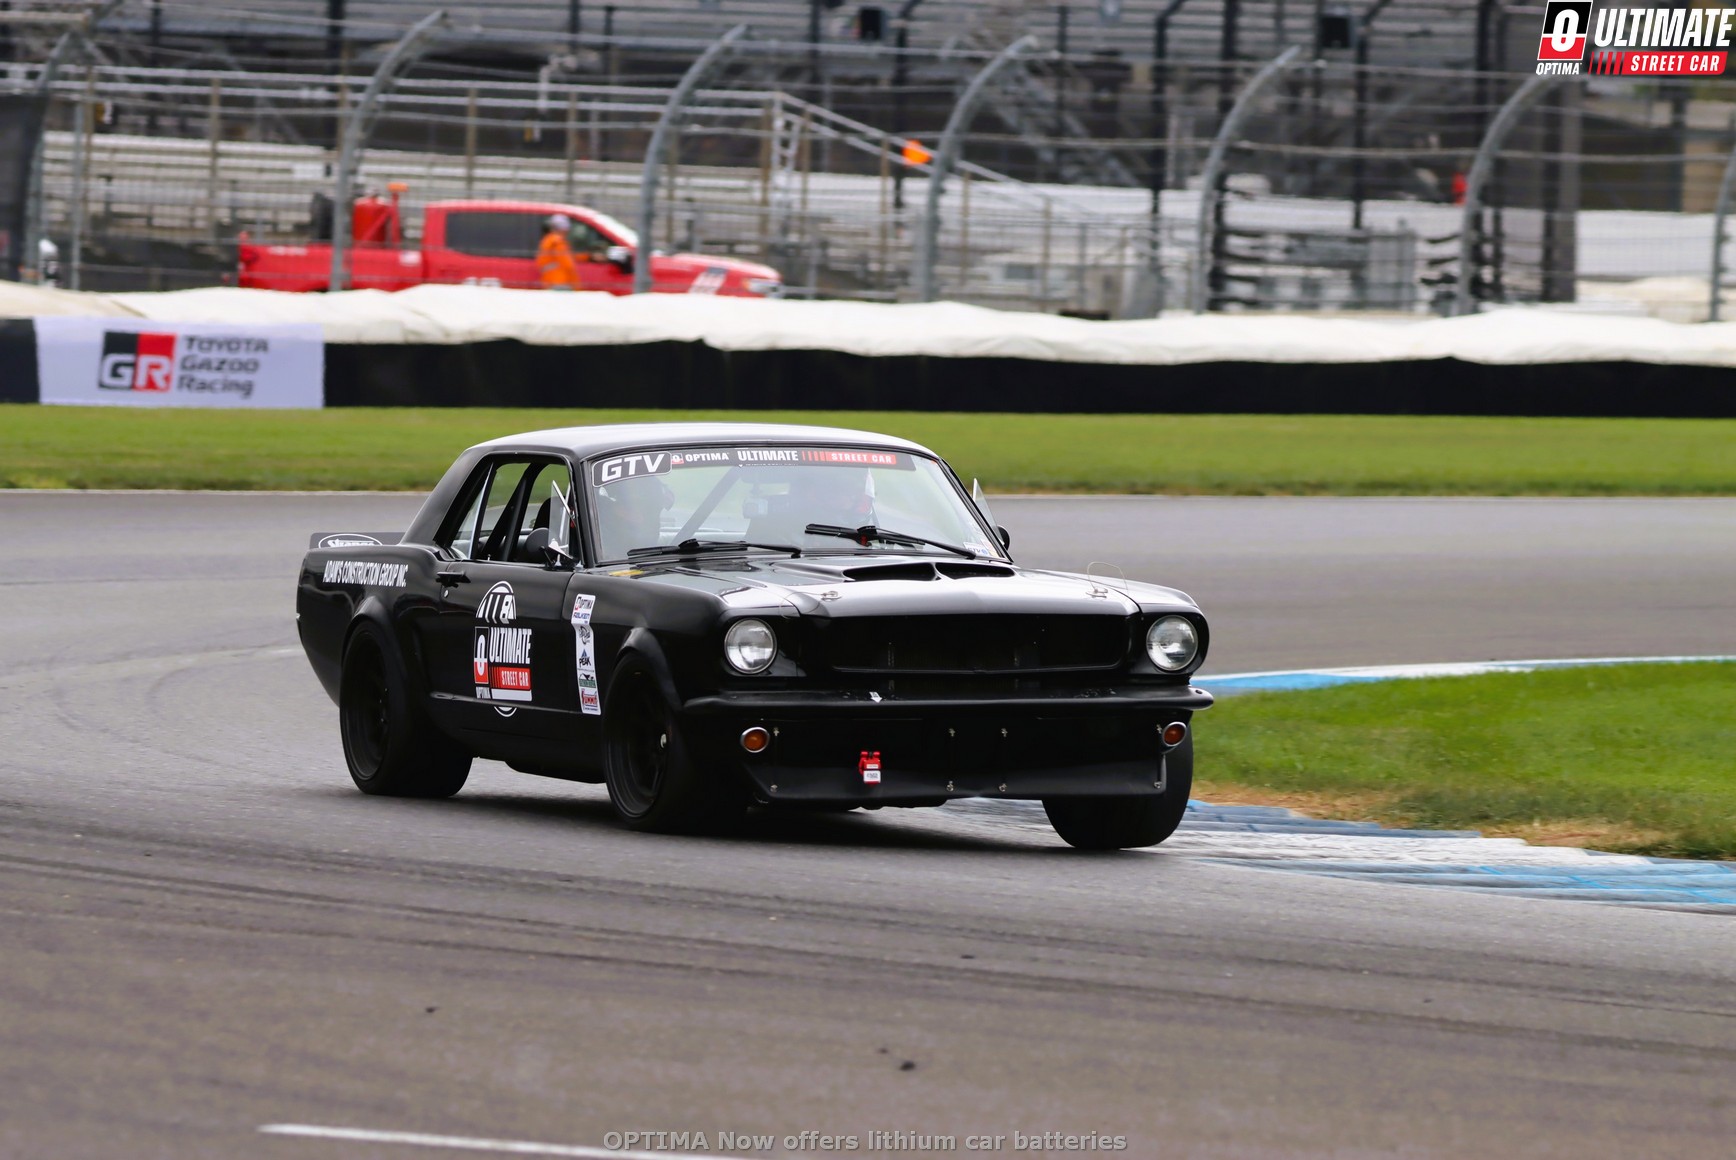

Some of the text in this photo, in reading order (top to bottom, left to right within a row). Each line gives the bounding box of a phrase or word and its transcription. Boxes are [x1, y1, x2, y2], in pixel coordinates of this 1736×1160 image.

[101, 353, 173, 390] GR
[177, 373, 254, 399] Racing
[602, 454, 665, 482] GTV
[685, 452, 730, 462] OPTIMA
[737, 450, 799, 462] ULTIMATE
[831, 452, 867, 462] STREET
[871, 454, 892, 463] CAR
[489, 626, 532, 664] ULTIMATE
[501, 670, 529, 687] STREET CAR
